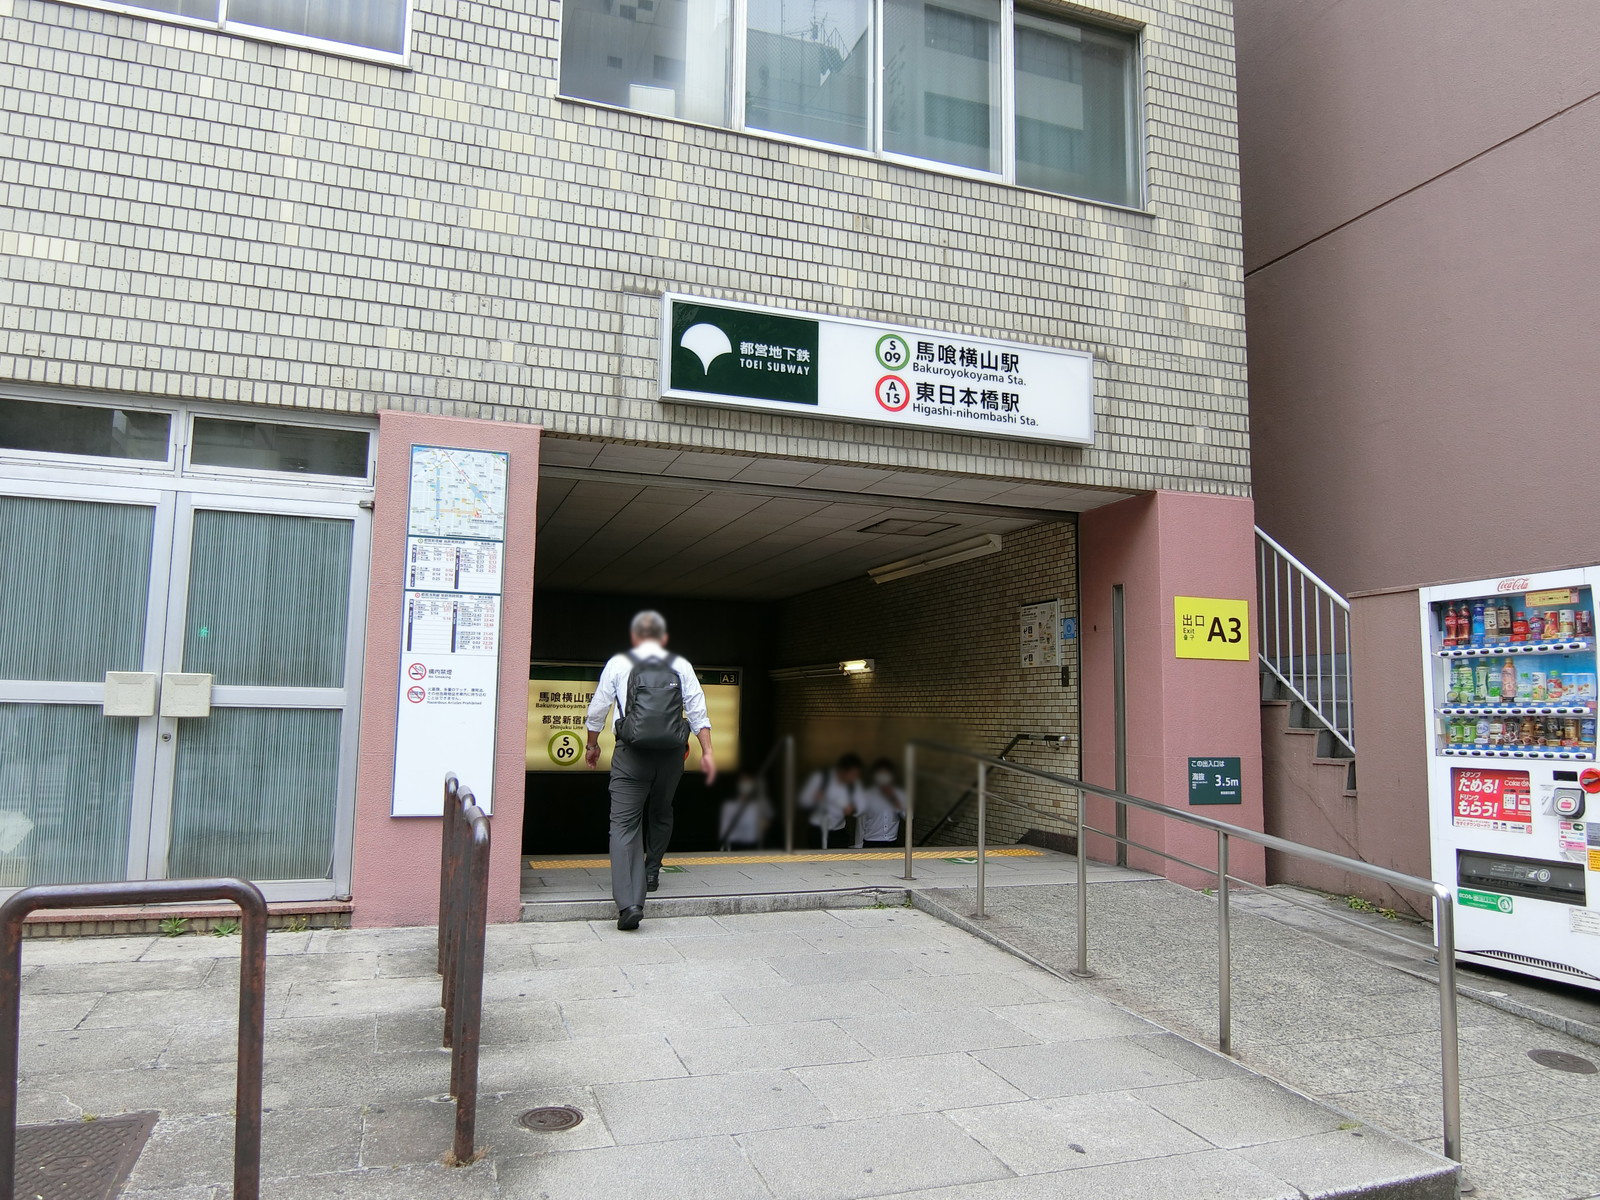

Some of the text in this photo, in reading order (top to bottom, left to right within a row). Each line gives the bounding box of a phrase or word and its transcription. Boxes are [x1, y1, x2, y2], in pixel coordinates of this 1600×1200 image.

[889, 340, 896, 351] S
[740, 341, 810, 363] 都営地下鉄
[884, 351, 902, 363] 09
[916, 341, 1019, 374] 馬喰横山駅
[740, 358, 810, 376] TOEI SUBWAY
[913, 362, 1027, 386] Bakuroyokoyama Sta.
[888, 381, 897, 392] A
[885, 392, 901, 404] 15
[916, 381, 1020, 413] 東日本橋駅
[913, 403, 1039, 427] Higashi-nihombashi Sta.
[1183, 614, 1204, 627] 出口
[1183, 627, 1195, 635] Exit
[1207, 617, 1242, 643] A3
[722, 674, 735, 683] A3
[562, 736, 570, 747] S
[557, 747, 575, 759] 09
[1191, 760, 1226, 768] この出入口は
[1214, 774, 1239, 787] 3.5m
